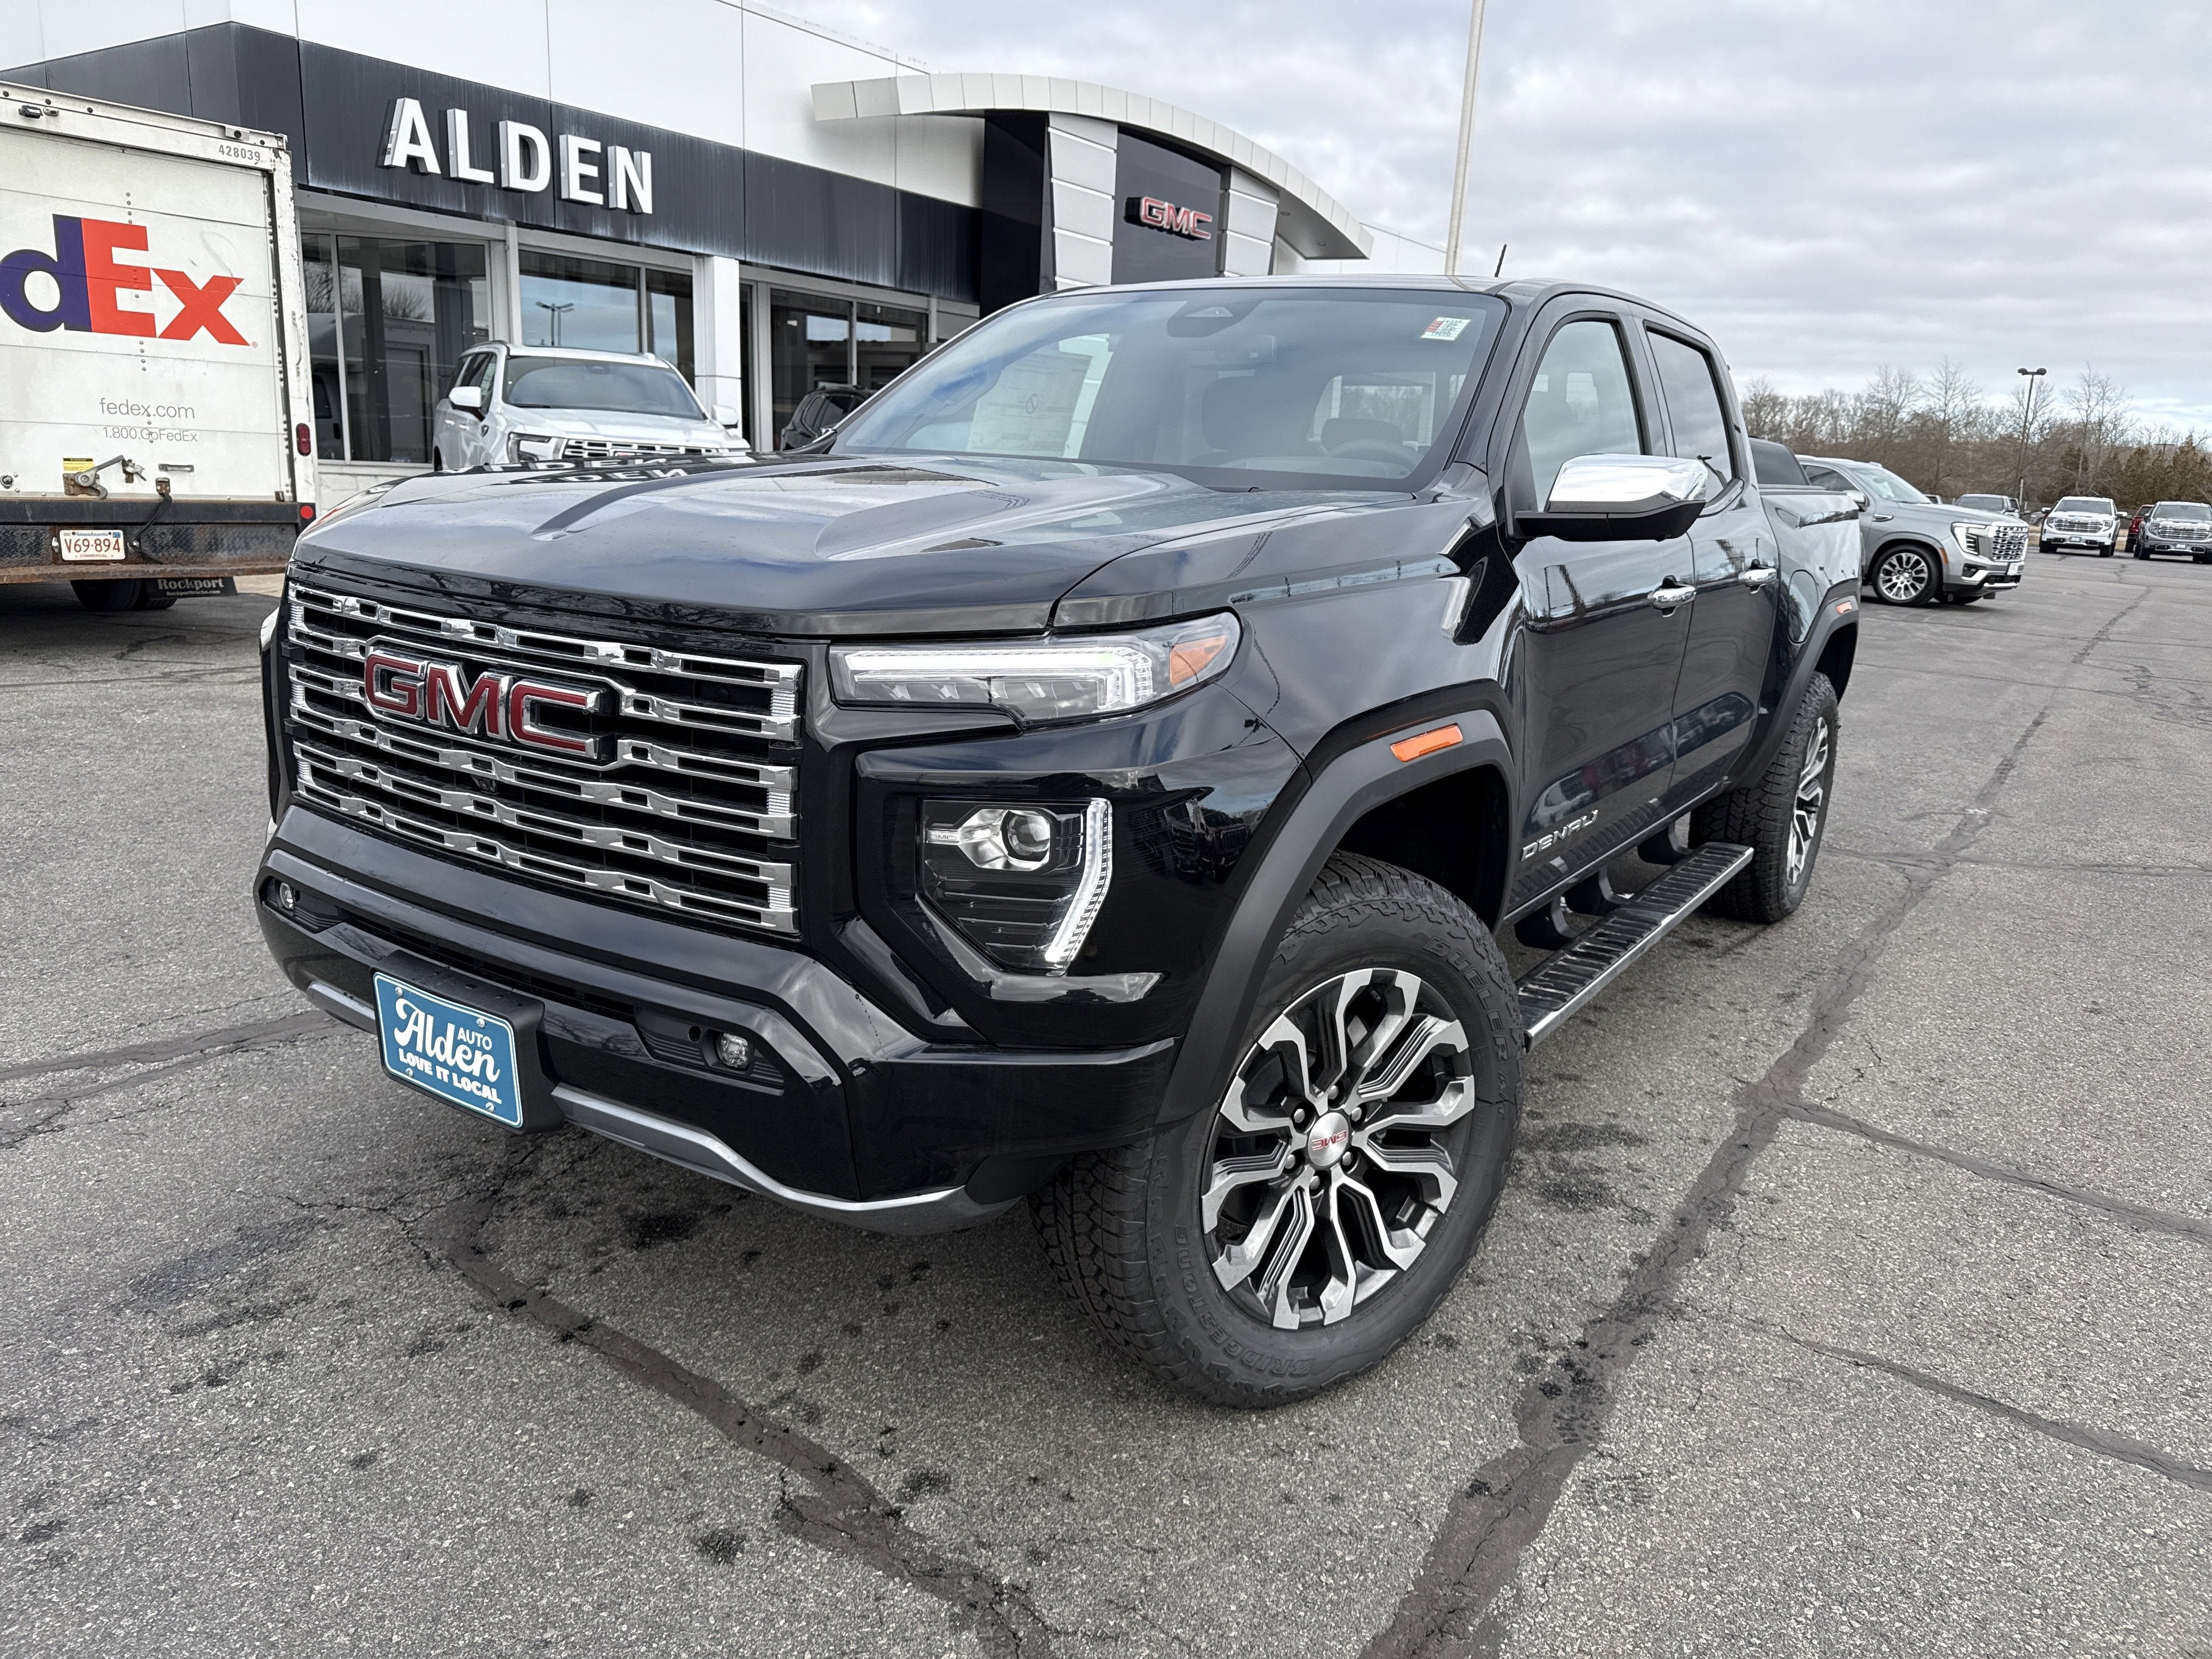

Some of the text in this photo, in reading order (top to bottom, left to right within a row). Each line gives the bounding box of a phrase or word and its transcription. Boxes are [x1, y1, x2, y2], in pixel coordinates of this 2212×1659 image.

[219, 144, 261, 161] 428039
[384, 97, 652, 214] ALDEN
[1140, 197, 1212, 240] GMC
[99, 398, 195, 419] fedex.com
[103, 427, 198, 442] 1.800.GoFedEx
[158, 578, 224, 590] Rockport
[365, 647, 602, 759] GMC
[1519, 809, 1599, 861] DENALI
[1422, 935, 1508, 1062] DUELER
[394, 998, 500, 1082] Alden
[458, 1027, 492, 1051] AUTO
[398, 1048, 502, 1104] LOVE IT LOCAL
[1312, 1130, 1346, 1151] GMC
[1175, 1224, 1317, 1378] BRIDGESTONE
